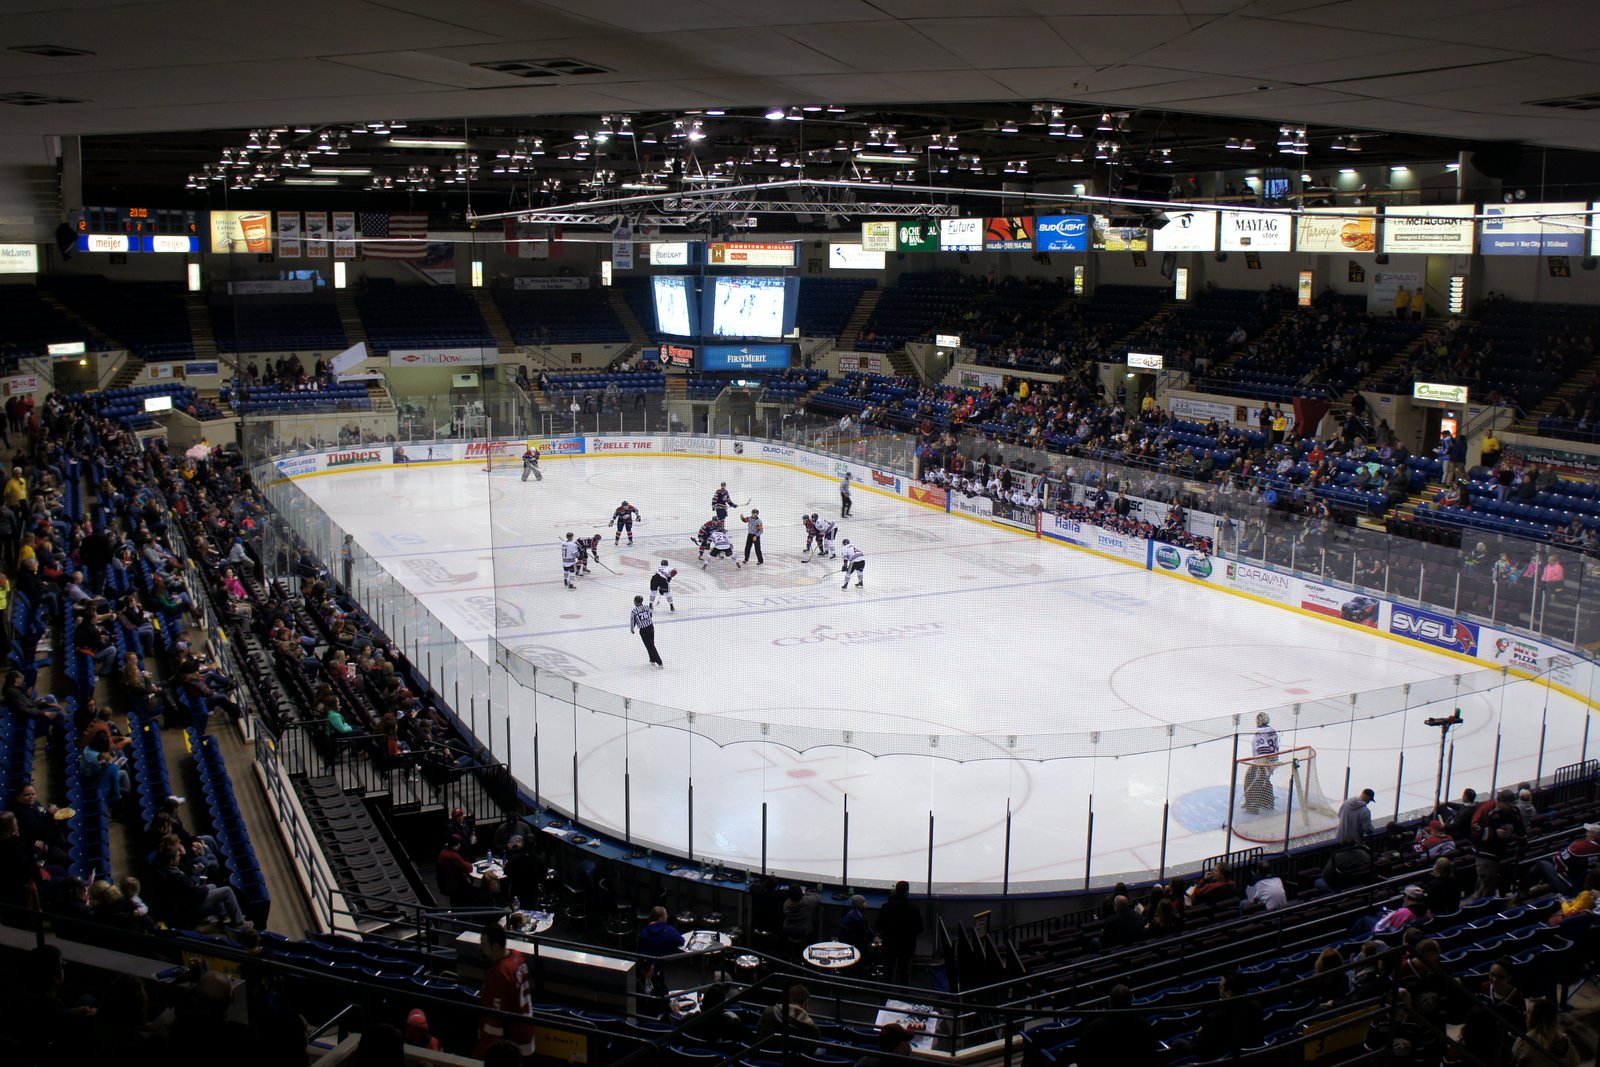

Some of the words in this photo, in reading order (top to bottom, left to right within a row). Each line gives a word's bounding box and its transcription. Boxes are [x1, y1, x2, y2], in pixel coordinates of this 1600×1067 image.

[948, 220, 975, 233] Future
[1039, 223, 1057, 231] BUD
[1060, 223, 1086, 231] LIGHT
[1235, 218, 1278, 231] MAYTAG
[95, 236, 121, 250] meijer
[161, 238, 183, 250] meijer
[632, 441, 652, 449] TIRE
[327, 450, 382, 464] Timbers
[960, 501, 977, 513] Merrill
[977, 505, 992, 517] Lynch
[1237, 566, 1289, 589] CARAVAN
[1392, 612, 1458, 644] SVSU
[1513, 653, 1537, 665] PIZZA
